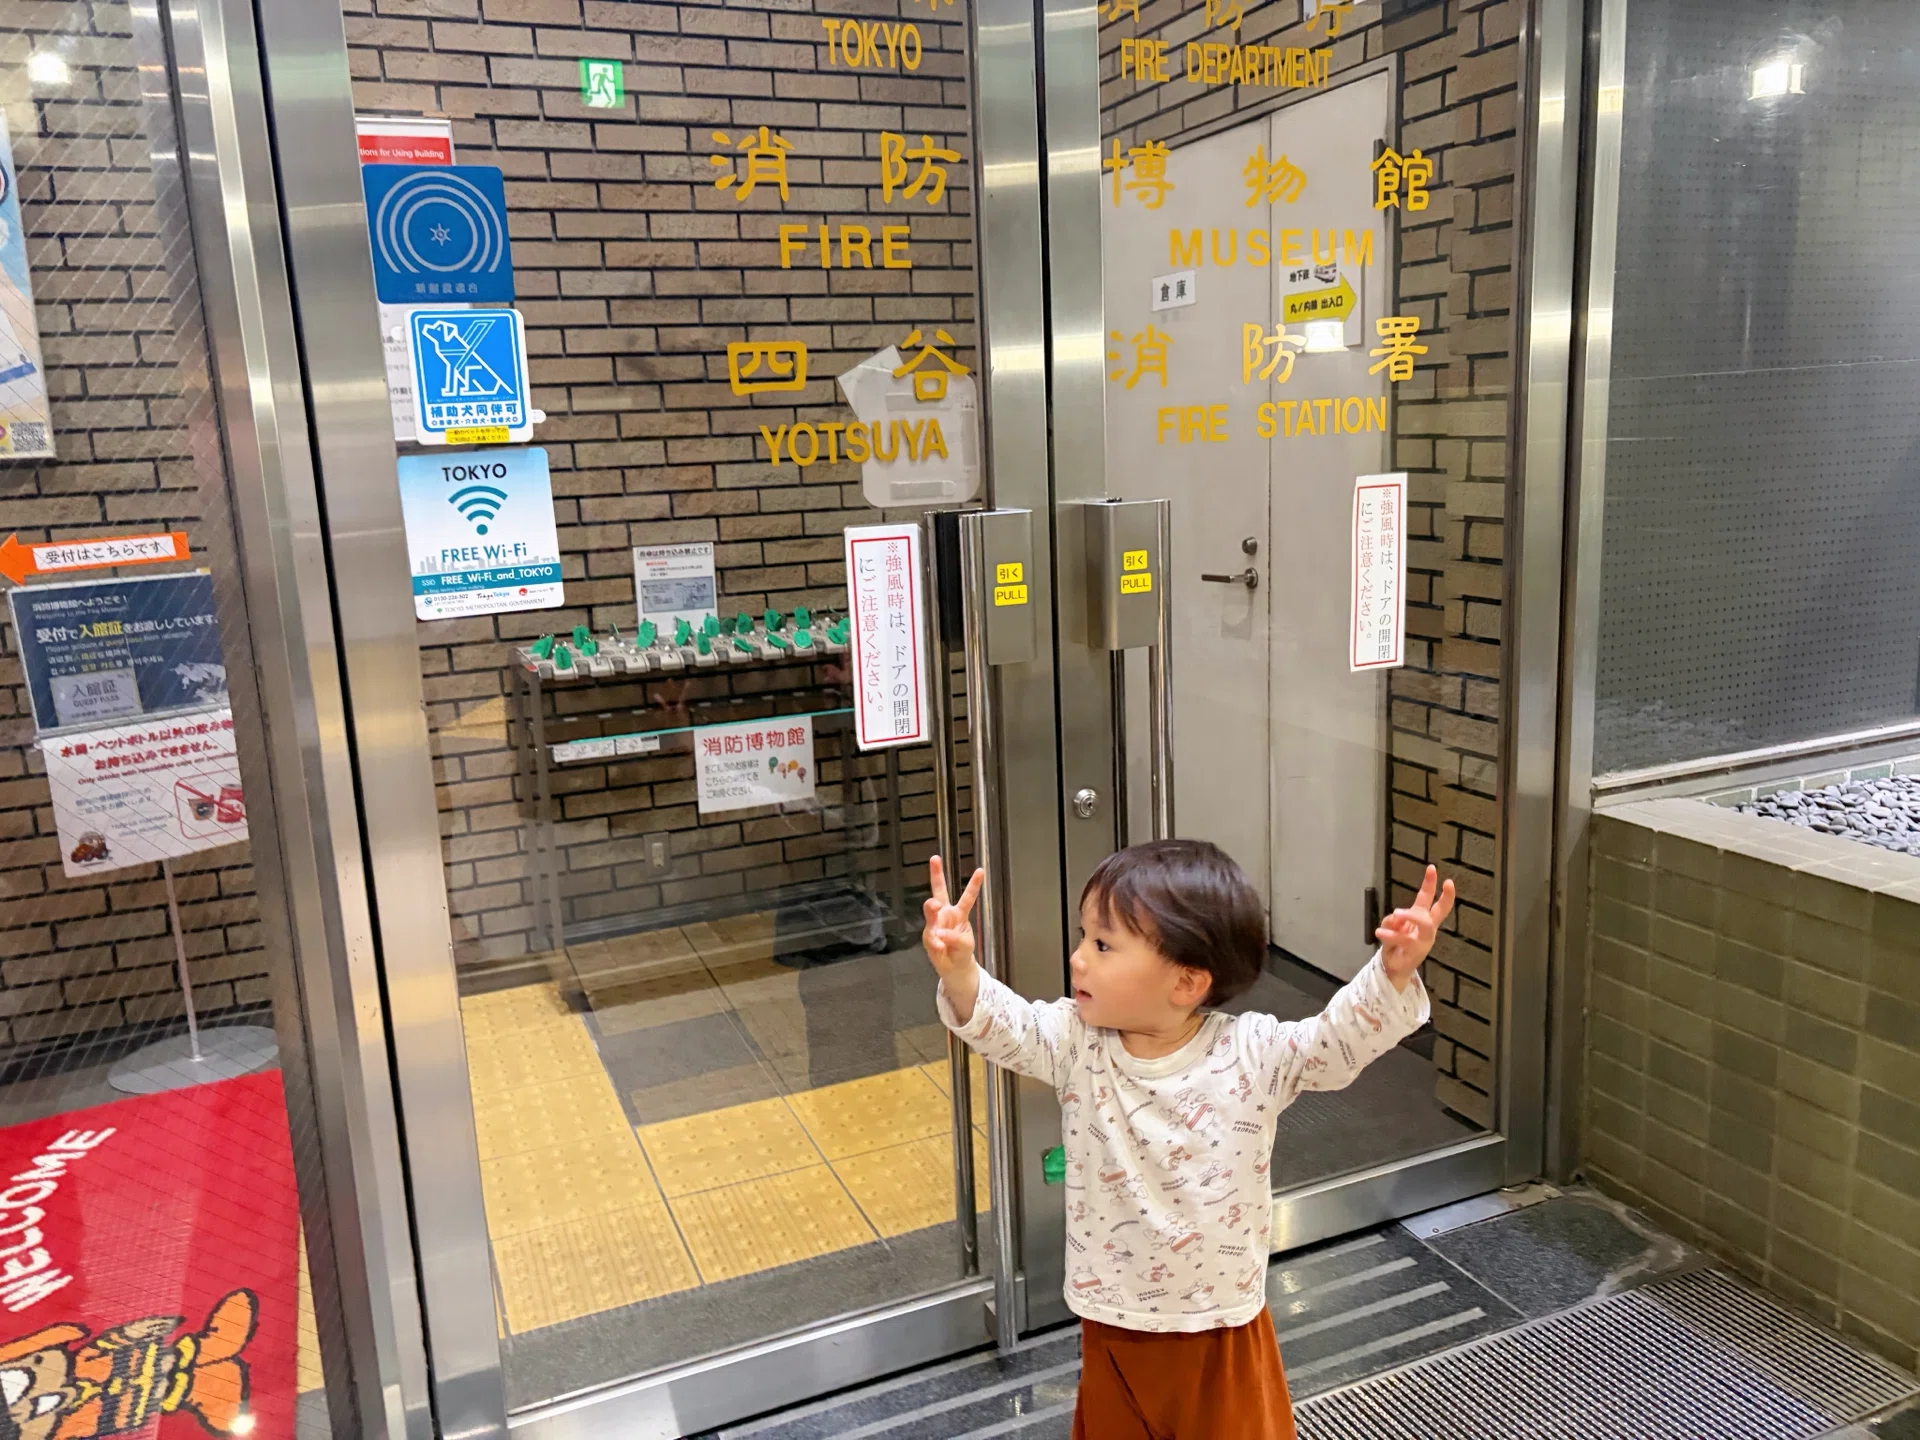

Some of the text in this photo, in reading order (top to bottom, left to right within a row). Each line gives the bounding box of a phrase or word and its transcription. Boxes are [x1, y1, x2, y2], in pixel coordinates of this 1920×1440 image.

[822, 19, 1333, 89] TOKYO FIRE DEPARTMENT
[380, 148, 391, 158] for
[392, 149, 413, 160] Using
[415, 150, 444, 160] Building
[709, 126, 1434, 212] 消防 博物館
[779, 224, 1373, 269] FIRE MUSEUM
[1160, 279, 1187, 302] 倉庫
[1320, 295, 1344, 309] 出入口
[727, 316, 1429, 402] 四谷 消防署
[430, 402, 518, 418] 補助犬同伴可
[760, 396, 1387, 467] YOTSUYA FIRE STATION
[442, 463, 507, 482] TOKYO
[45, 542, 161, 564] 受付はこちらです
[441, 542, 528, 563] FREE Wi-Fi
[1125, 555, 1143, 567] 引く
[1000, 568, 1018, 580] 引く
[1360, 502, 1374, 640] にご注意ください。
[1122, 577, 1149, 589] PULL
[996, 590, 1025, 601] PULL
[859, 557, 884, 713] にご注意ください。
[702, 728, 806, 757] 消防博物館
[0, 1127, 117, 1313] WELCOME
